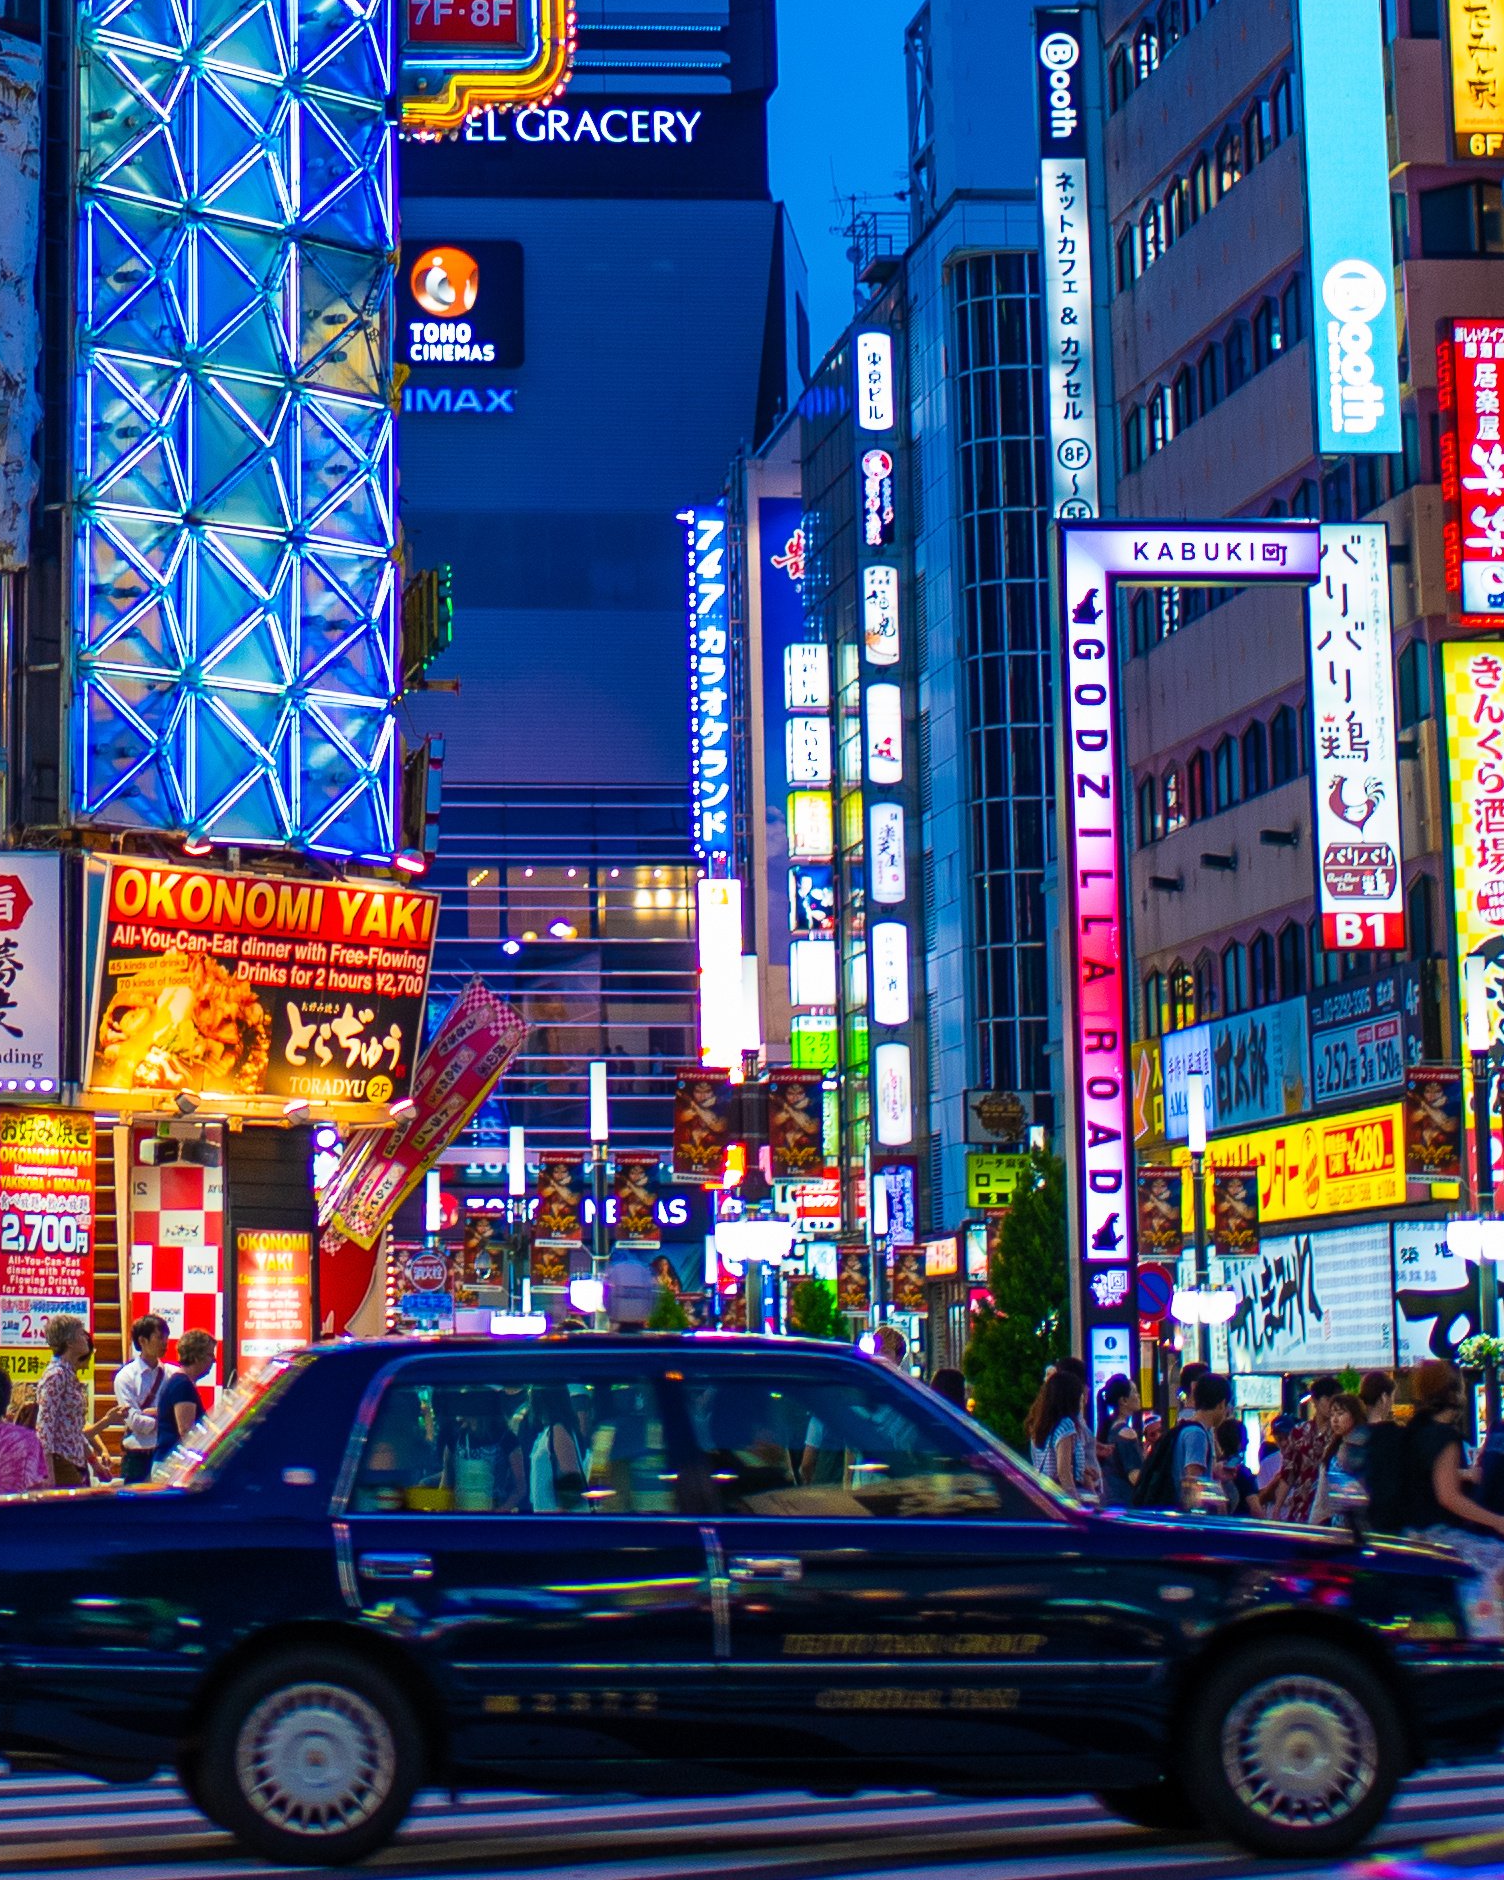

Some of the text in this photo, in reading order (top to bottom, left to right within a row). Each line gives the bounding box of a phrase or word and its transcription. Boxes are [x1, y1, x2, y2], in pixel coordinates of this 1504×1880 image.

[515, 109, 702, 143] GRACERY
[1468, 134, 1504, 157] 6F
[1055, 172, 1083, 422] ネットカフェ カプセル
[409, 322, 472, 344] TOHO
[409, 344, 495, 362] CINEMAS
[403, 387, 515, 414] IMAX
[1473, 362, 1500, 442] 居楽屋
[1063, 445, 1085, 464] 8F
[696, 519, 731, 842] 747 カラオケランド
[113, 866, 434, 943] OKONOMI YAKI
[1072, 637, 1125, 1195] GODZILLA ROAD
[112, 924, 428, 973] All-You-Can-Eat Free-Flowing
[1334, 916, 1388, 948] B1
[236, 962, 424, 997] Drinks hours ¥2,700
[288, 1075, 368, 1099] TORADYU
[0, 1214, 90, 1254] 2,700円
